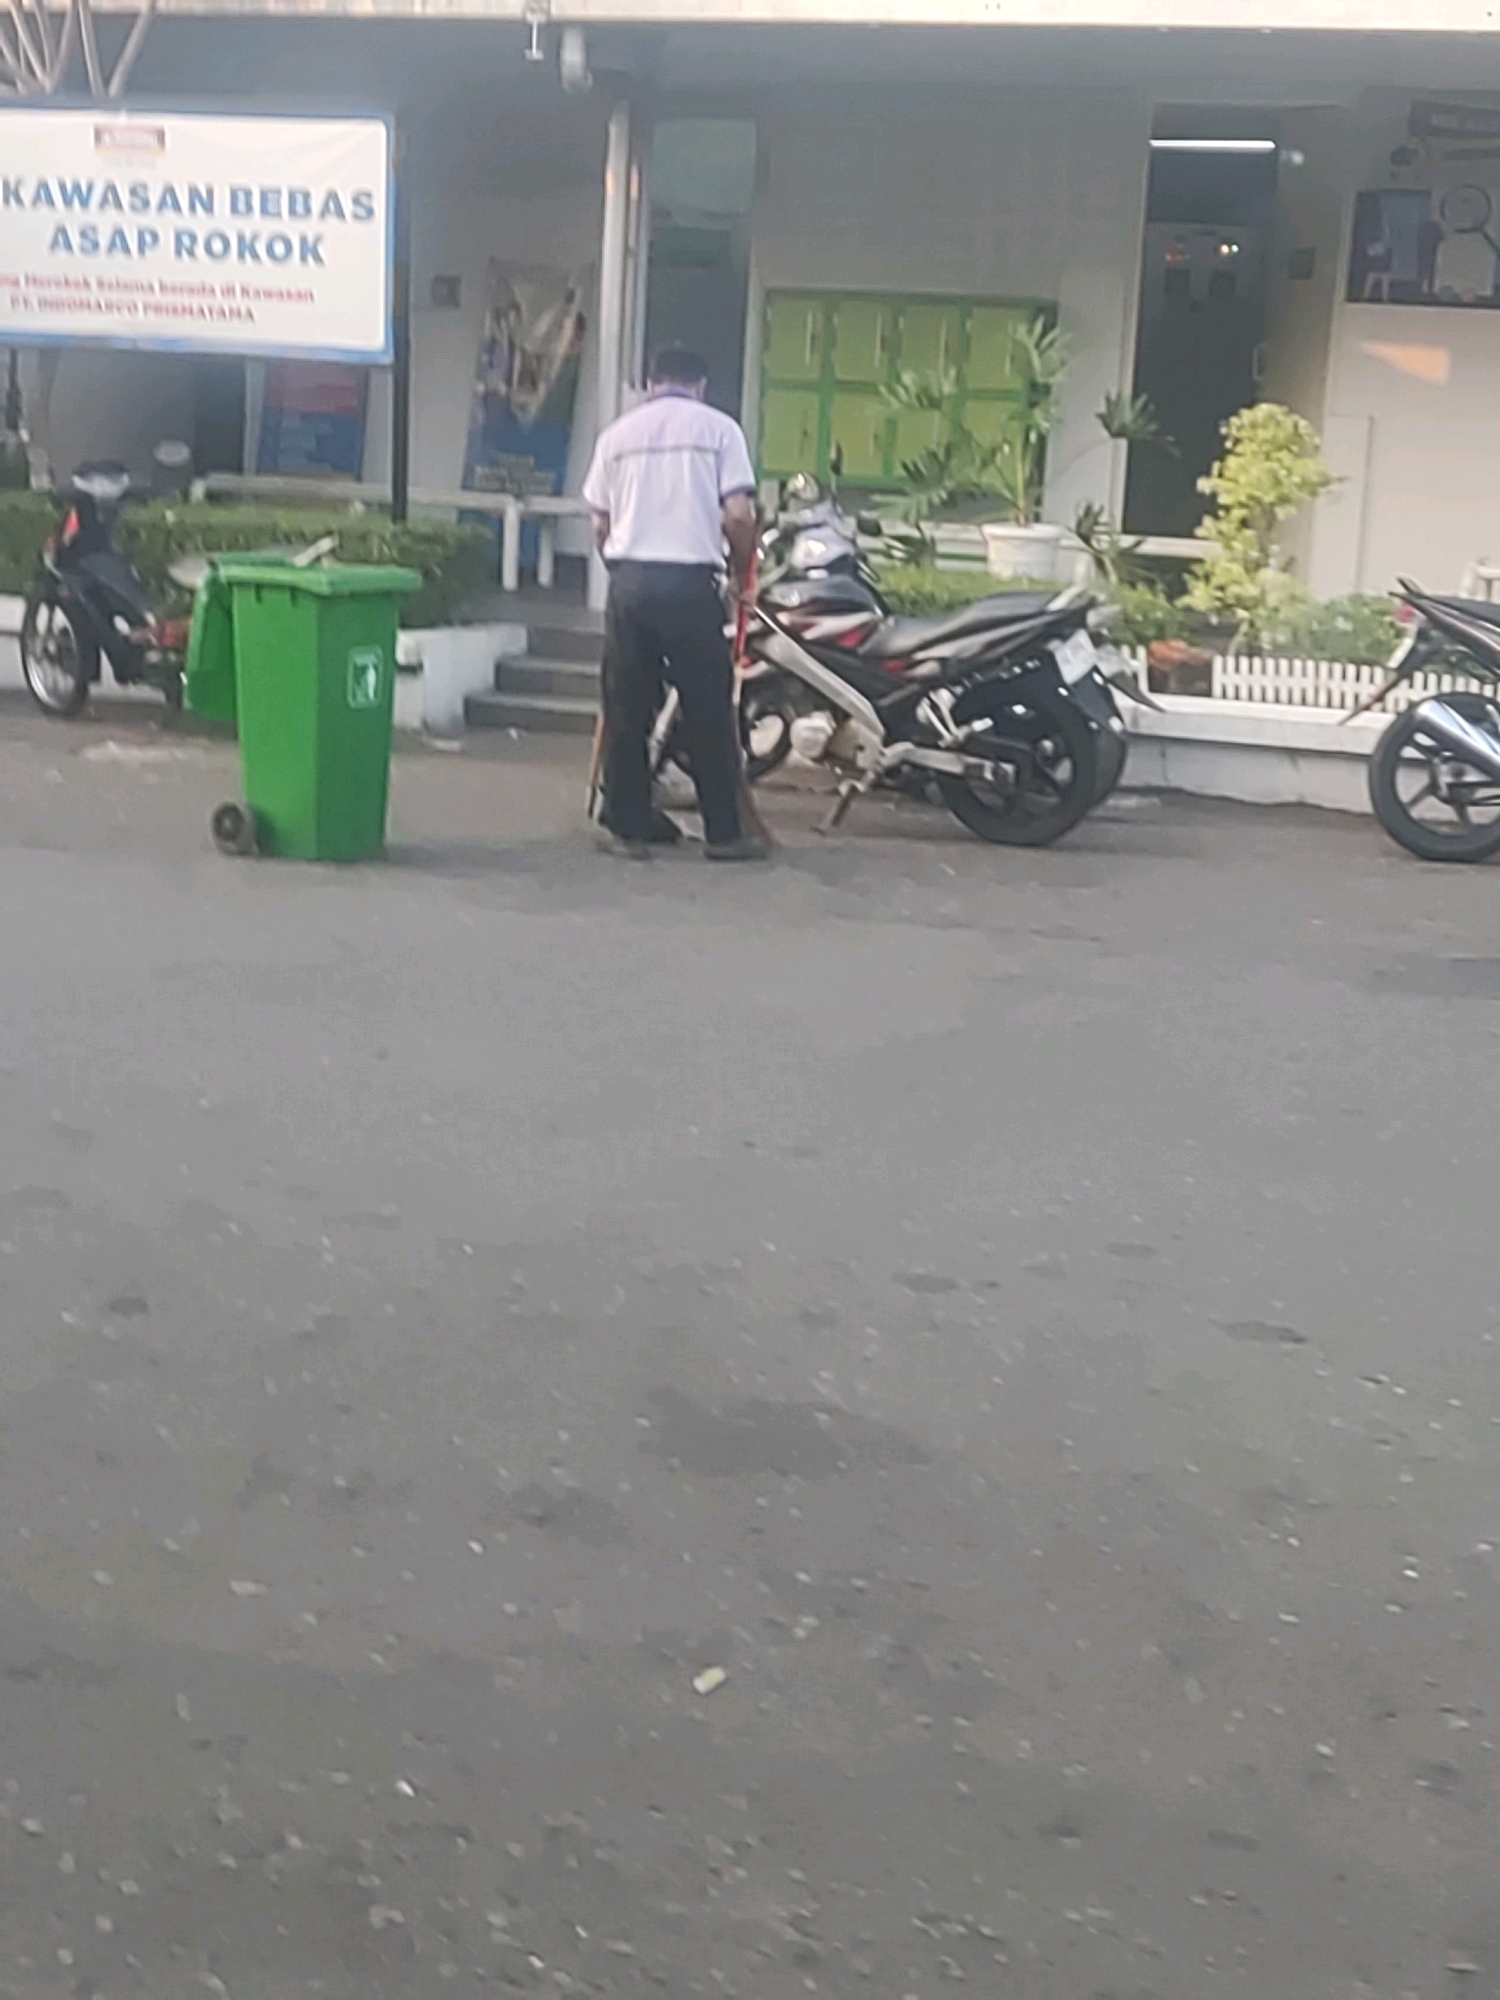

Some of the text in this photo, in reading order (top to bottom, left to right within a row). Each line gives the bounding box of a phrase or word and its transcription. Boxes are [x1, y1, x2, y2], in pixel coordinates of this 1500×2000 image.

[1, 175, 375, 222] KAWASAN BEBAS
[50, 223, 326, 265] ASAP ROKOK
[220, 282, 236, 299] di
[240, 284, 315, 305] Kawasan
